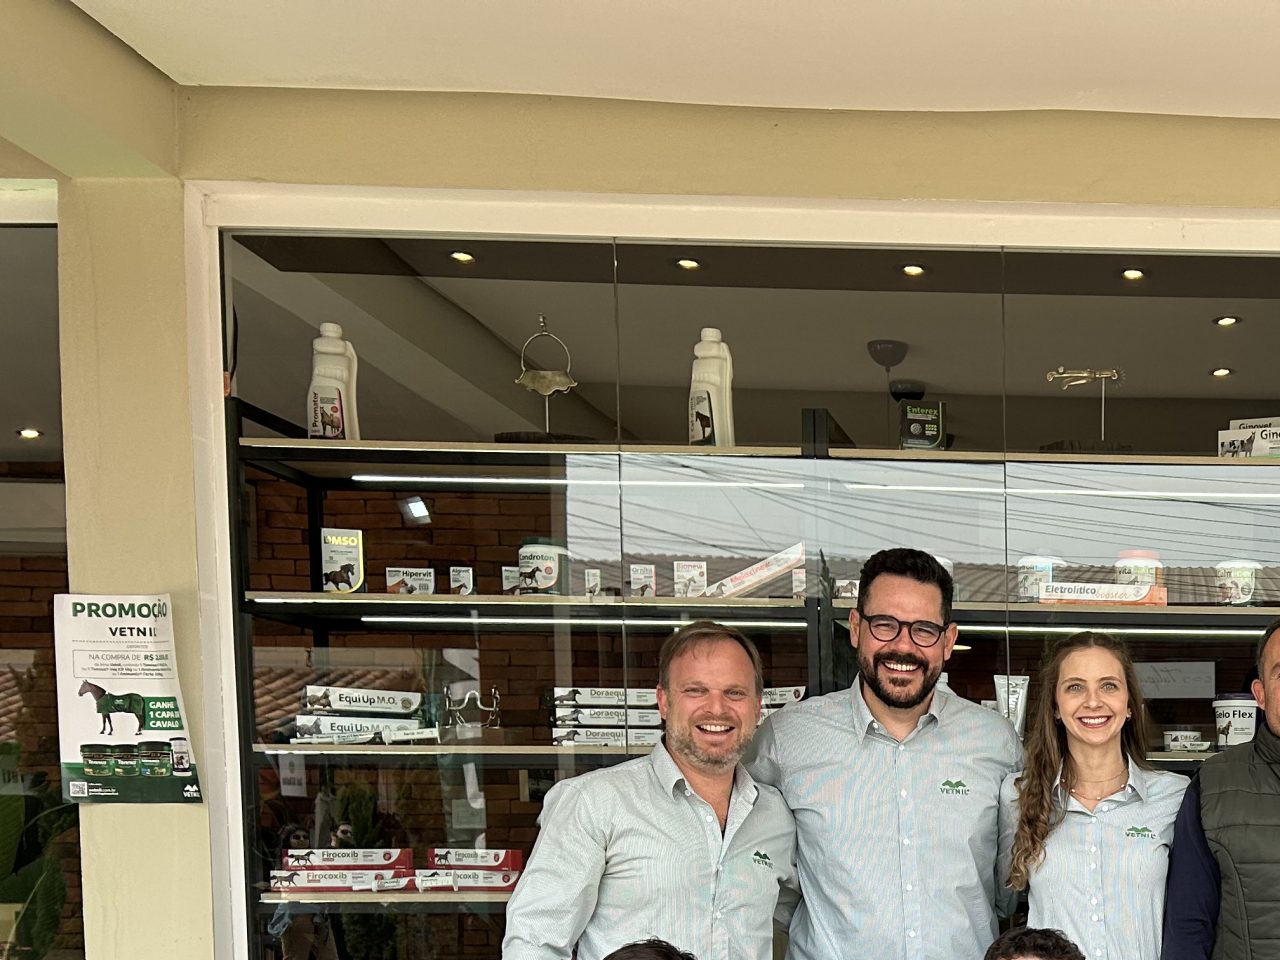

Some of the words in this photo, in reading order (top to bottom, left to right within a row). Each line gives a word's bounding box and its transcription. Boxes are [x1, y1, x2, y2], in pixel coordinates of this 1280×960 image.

[907, 405, 938, 416] Enterex
[402, 570, 432, 578] Hipervit
[72, 599, 167, 622] PROMOÇÃO
[109, 626, 157, 637] VETNIL
[590, 689, 625, 699] Doraequ
[590, 709, 625, 719] Doraequ
[1232, 709, 1254, 719] Flex
[940, 788, 970, 796] VETNIL
[322, 850, 359, 858] Firocoxib
[455, 850, 479, 858] Firocoxib
[306, 872, 348, 880] Firocoxib
